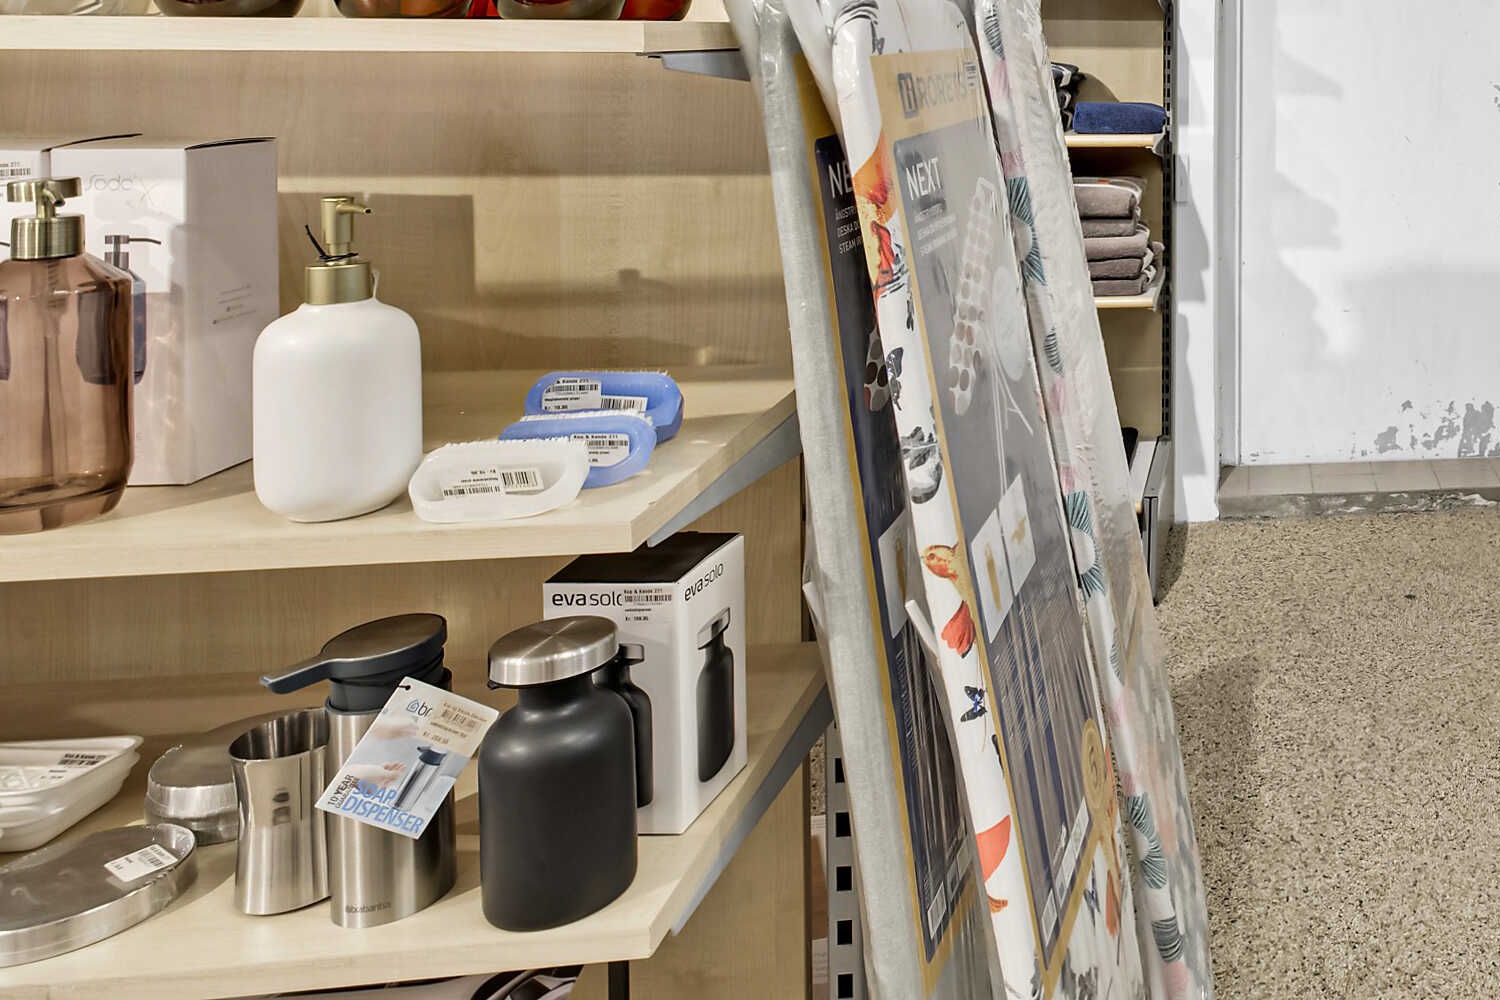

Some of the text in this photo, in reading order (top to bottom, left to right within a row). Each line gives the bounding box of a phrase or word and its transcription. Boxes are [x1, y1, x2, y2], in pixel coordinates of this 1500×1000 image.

[829, 163, 854, 198] NE
[906, 158, 944, 201] NEXT
[839, 239, 855, 254] STEAM
[684, 563, 724, 601] eva solo
[552, 593, 587, 606] eva
[328, 774, 355, 806] 10 YEAR
[352, 779, 398, 805] SOAP
[342, 796, 425, 834] DISPENSER
